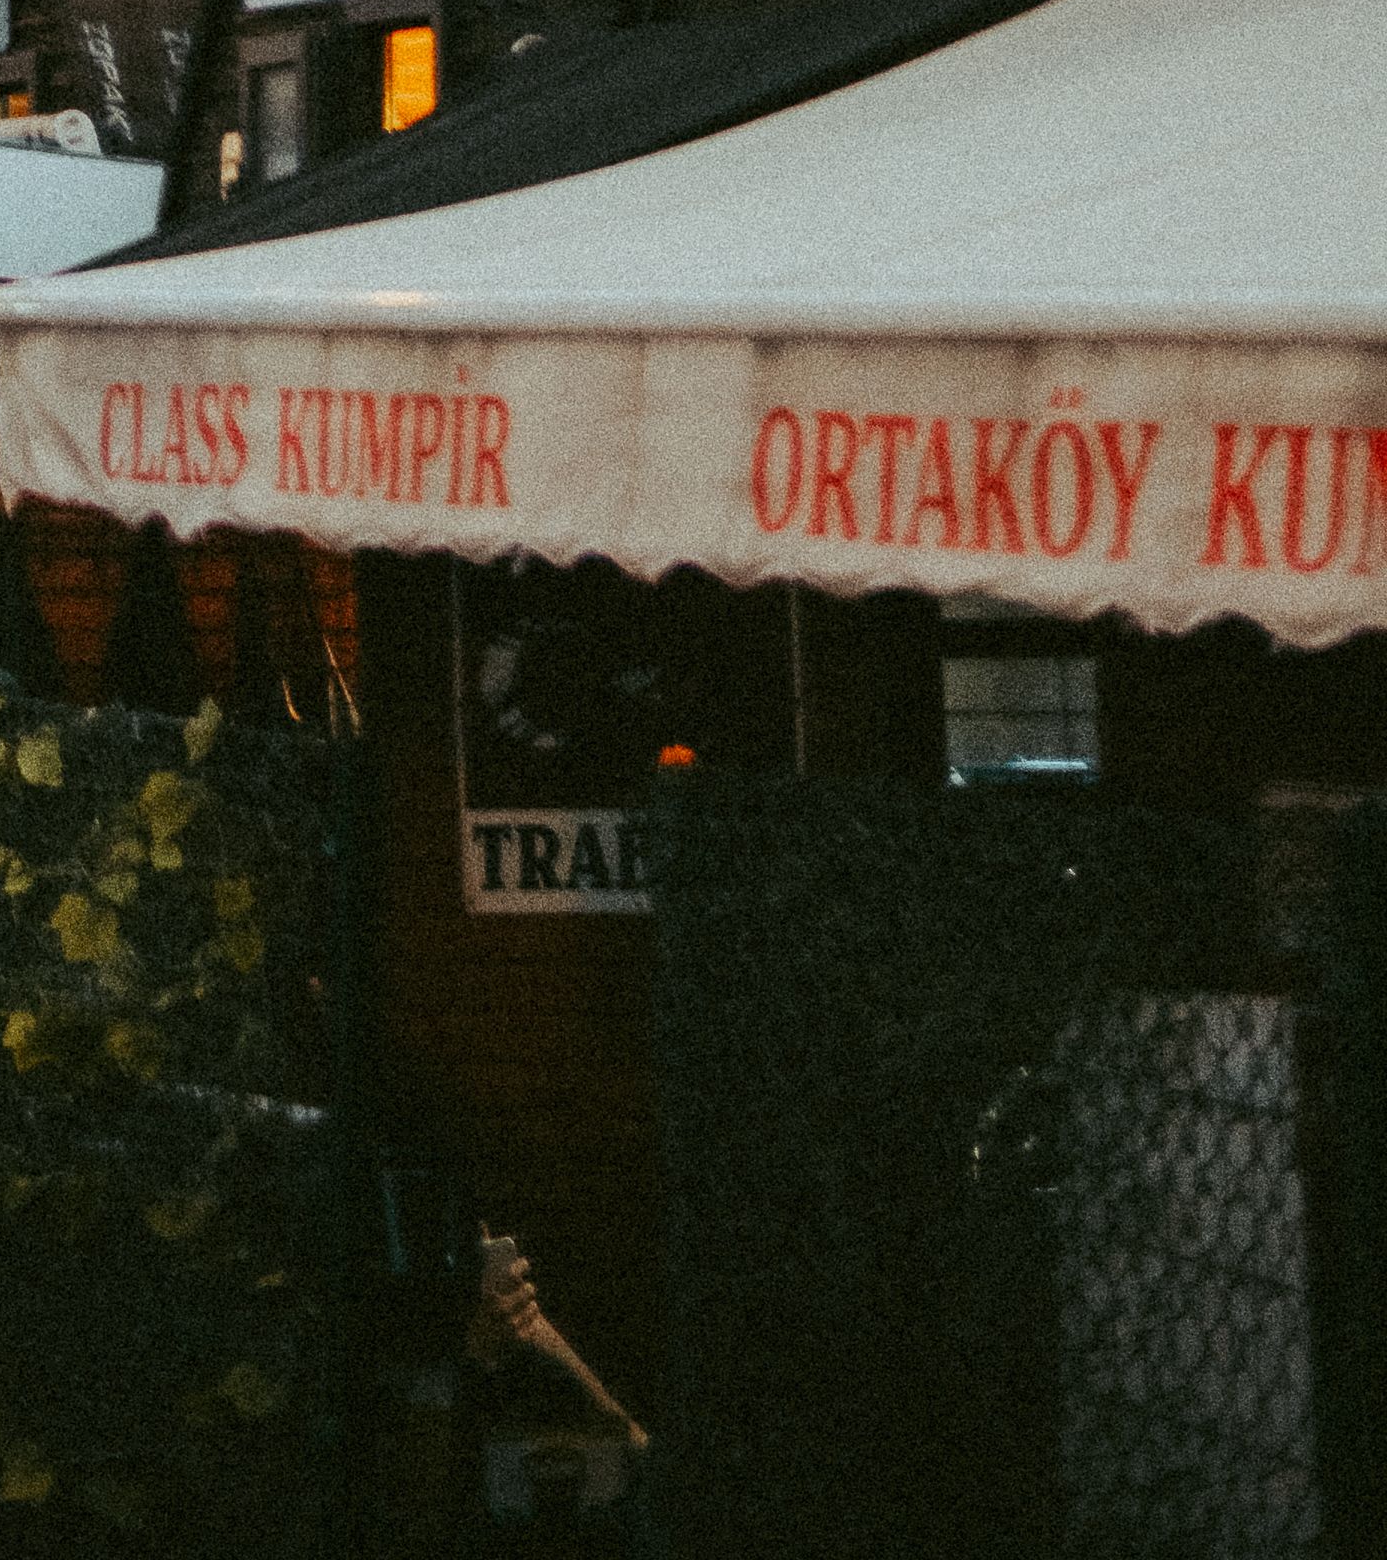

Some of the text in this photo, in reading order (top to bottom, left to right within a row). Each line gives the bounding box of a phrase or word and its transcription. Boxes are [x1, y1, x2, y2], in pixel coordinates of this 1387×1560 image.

[99, 364, 512, 508] CLASS KUMPİR
[749, 385, 1163, 561] ORTAKÖY
